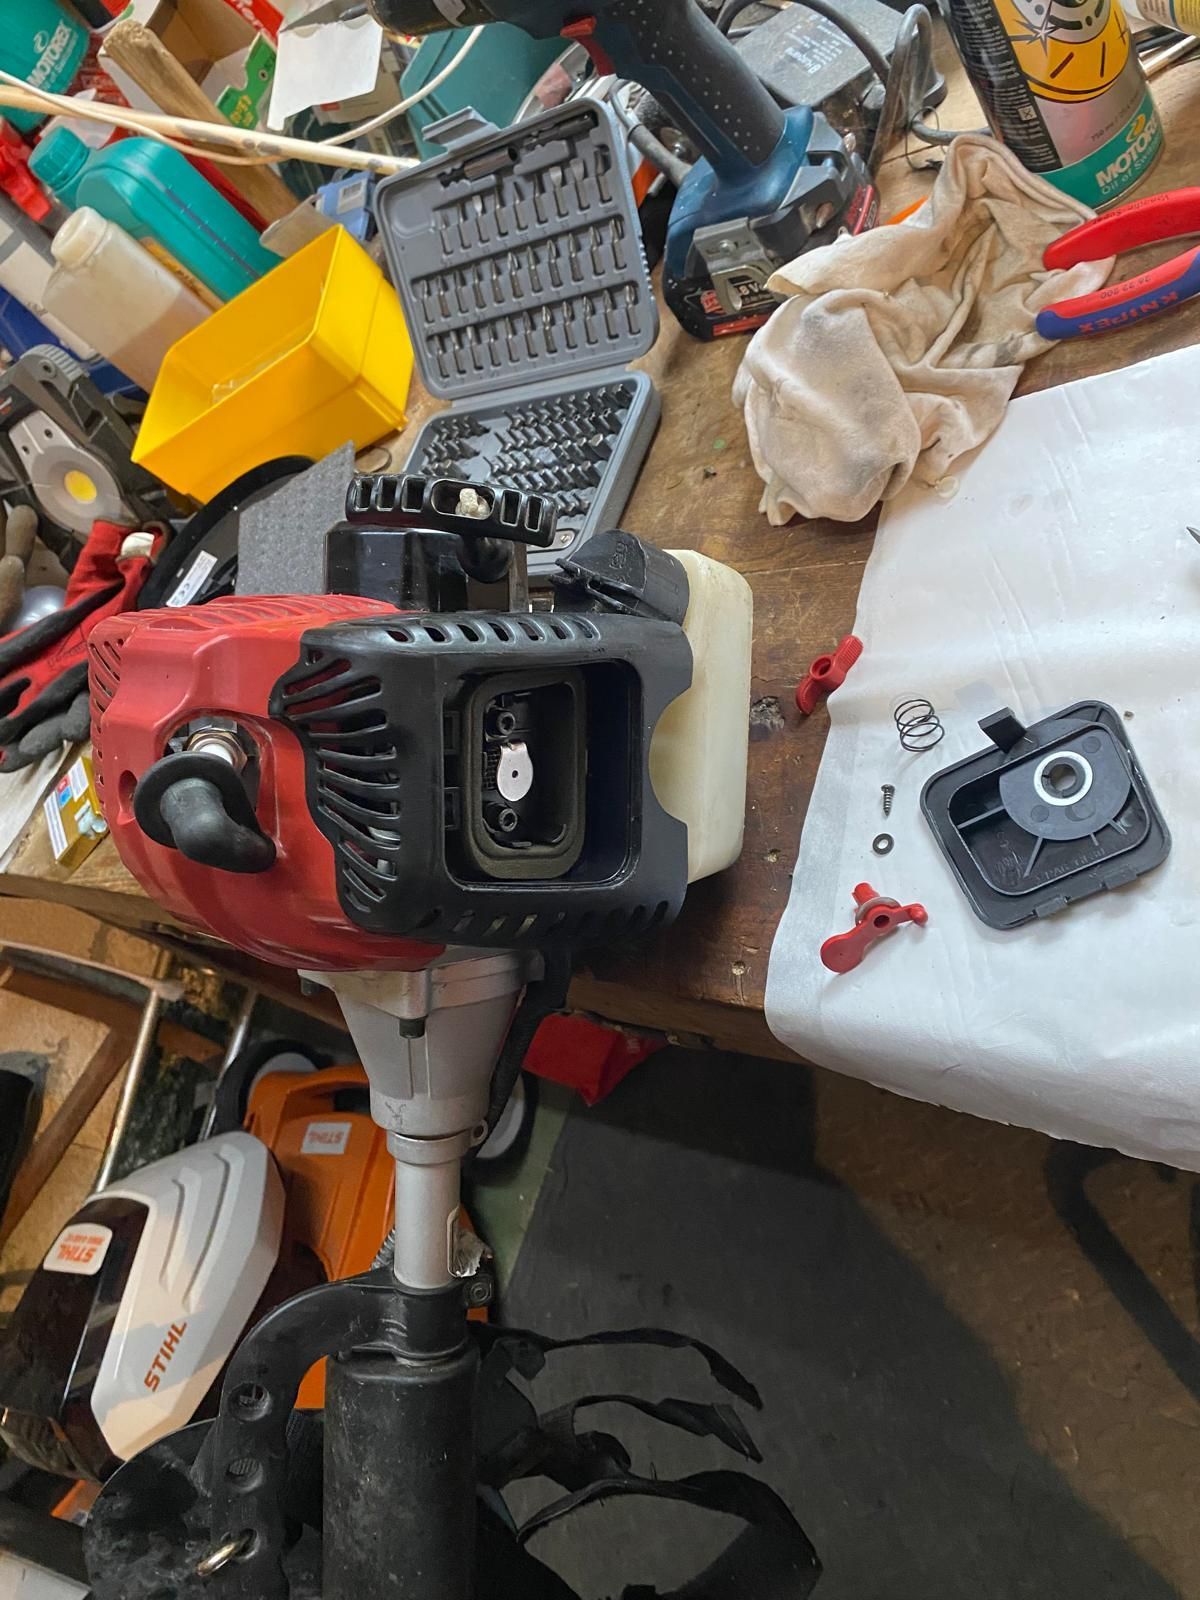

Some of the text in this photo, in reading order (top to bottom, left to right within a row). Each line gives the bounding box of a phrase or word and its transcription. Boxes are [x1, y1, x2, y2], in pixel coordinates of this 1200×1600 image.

[26, 19, 72, 88] MOTOREX
[1102, 168, 1134, 195] Oil of
[1078, 290, 1178, 333] KNIPEX
[308, 1131, 345, 1145] STIHL
[57, 1243, 97, 1264] STIHL
[144, 1322, 187, 1392] STIHL
